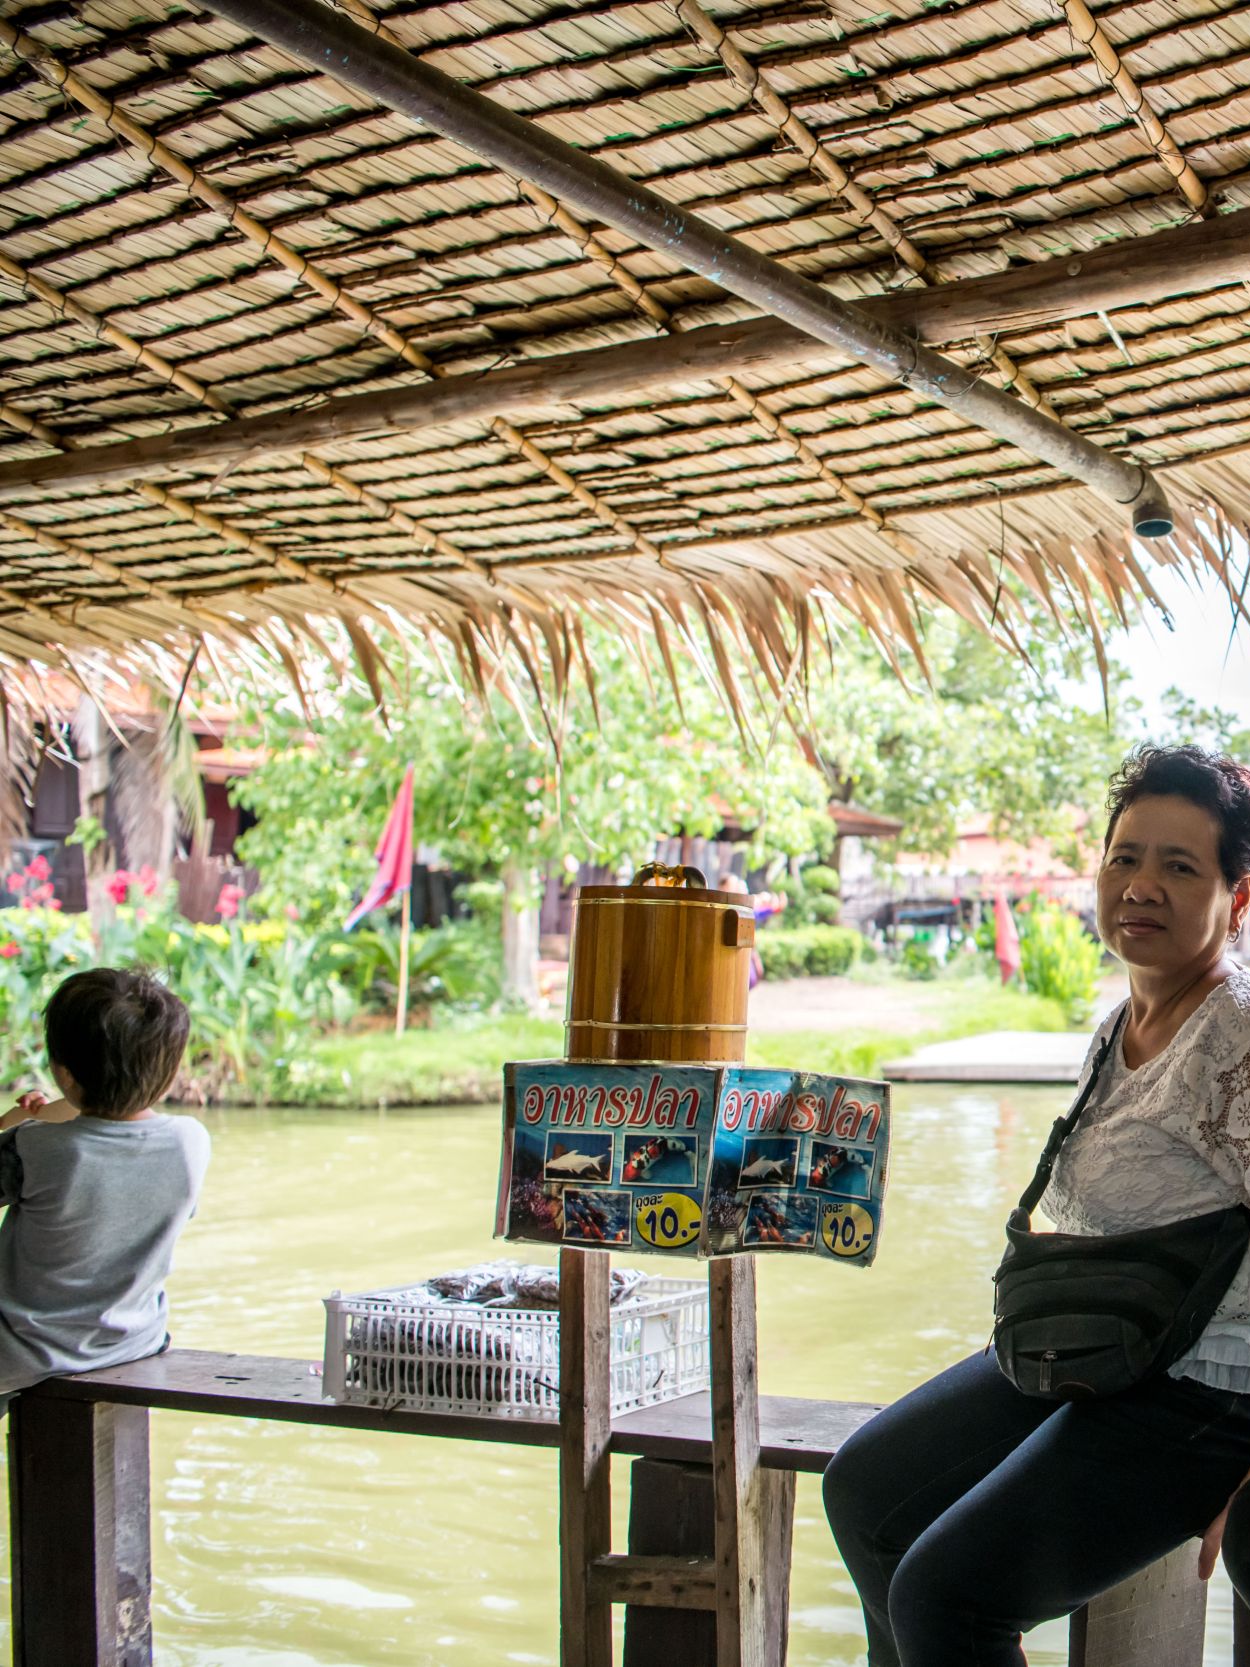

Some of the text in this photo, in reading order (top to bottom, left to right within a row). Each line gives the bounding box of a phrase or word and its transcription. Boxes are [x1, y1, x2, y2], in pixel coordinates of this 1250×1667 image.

[523, 1073, 701, 1128] อาหารปลา
[722, 1085, 882, 1142] อาหารปลา
[635, 1194, 664, 1212] ถุงละ
[821, 1203, 844, 1218] ถุงละ
